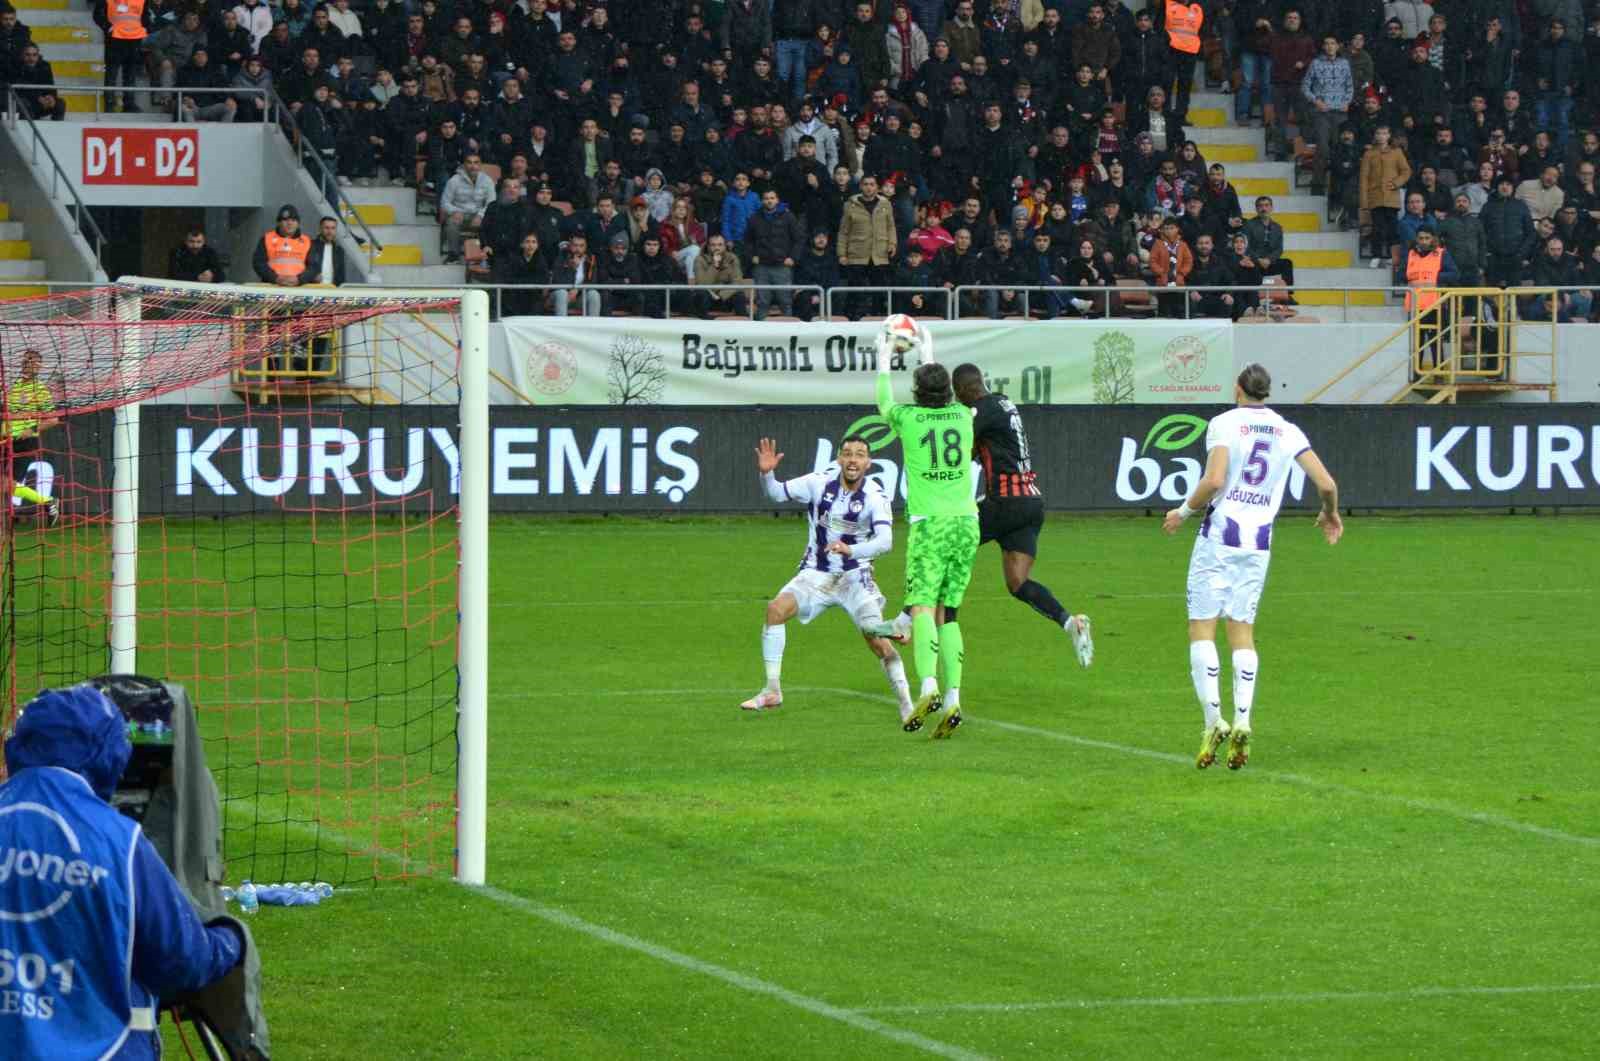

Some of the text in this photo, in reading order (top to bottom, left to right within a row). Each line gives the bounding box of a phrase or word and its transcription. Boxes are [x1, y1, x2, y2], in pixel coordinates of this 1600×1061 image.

[86, 137, 122, 176] D1
[155, 138, 194, 176] D2
[682, 333, 813, 377] Bağımlı
[919, 428, 962, 468] 18
[1242, 440, 1272, 486] 5
[1416, 425, 1600, 491] KUR
